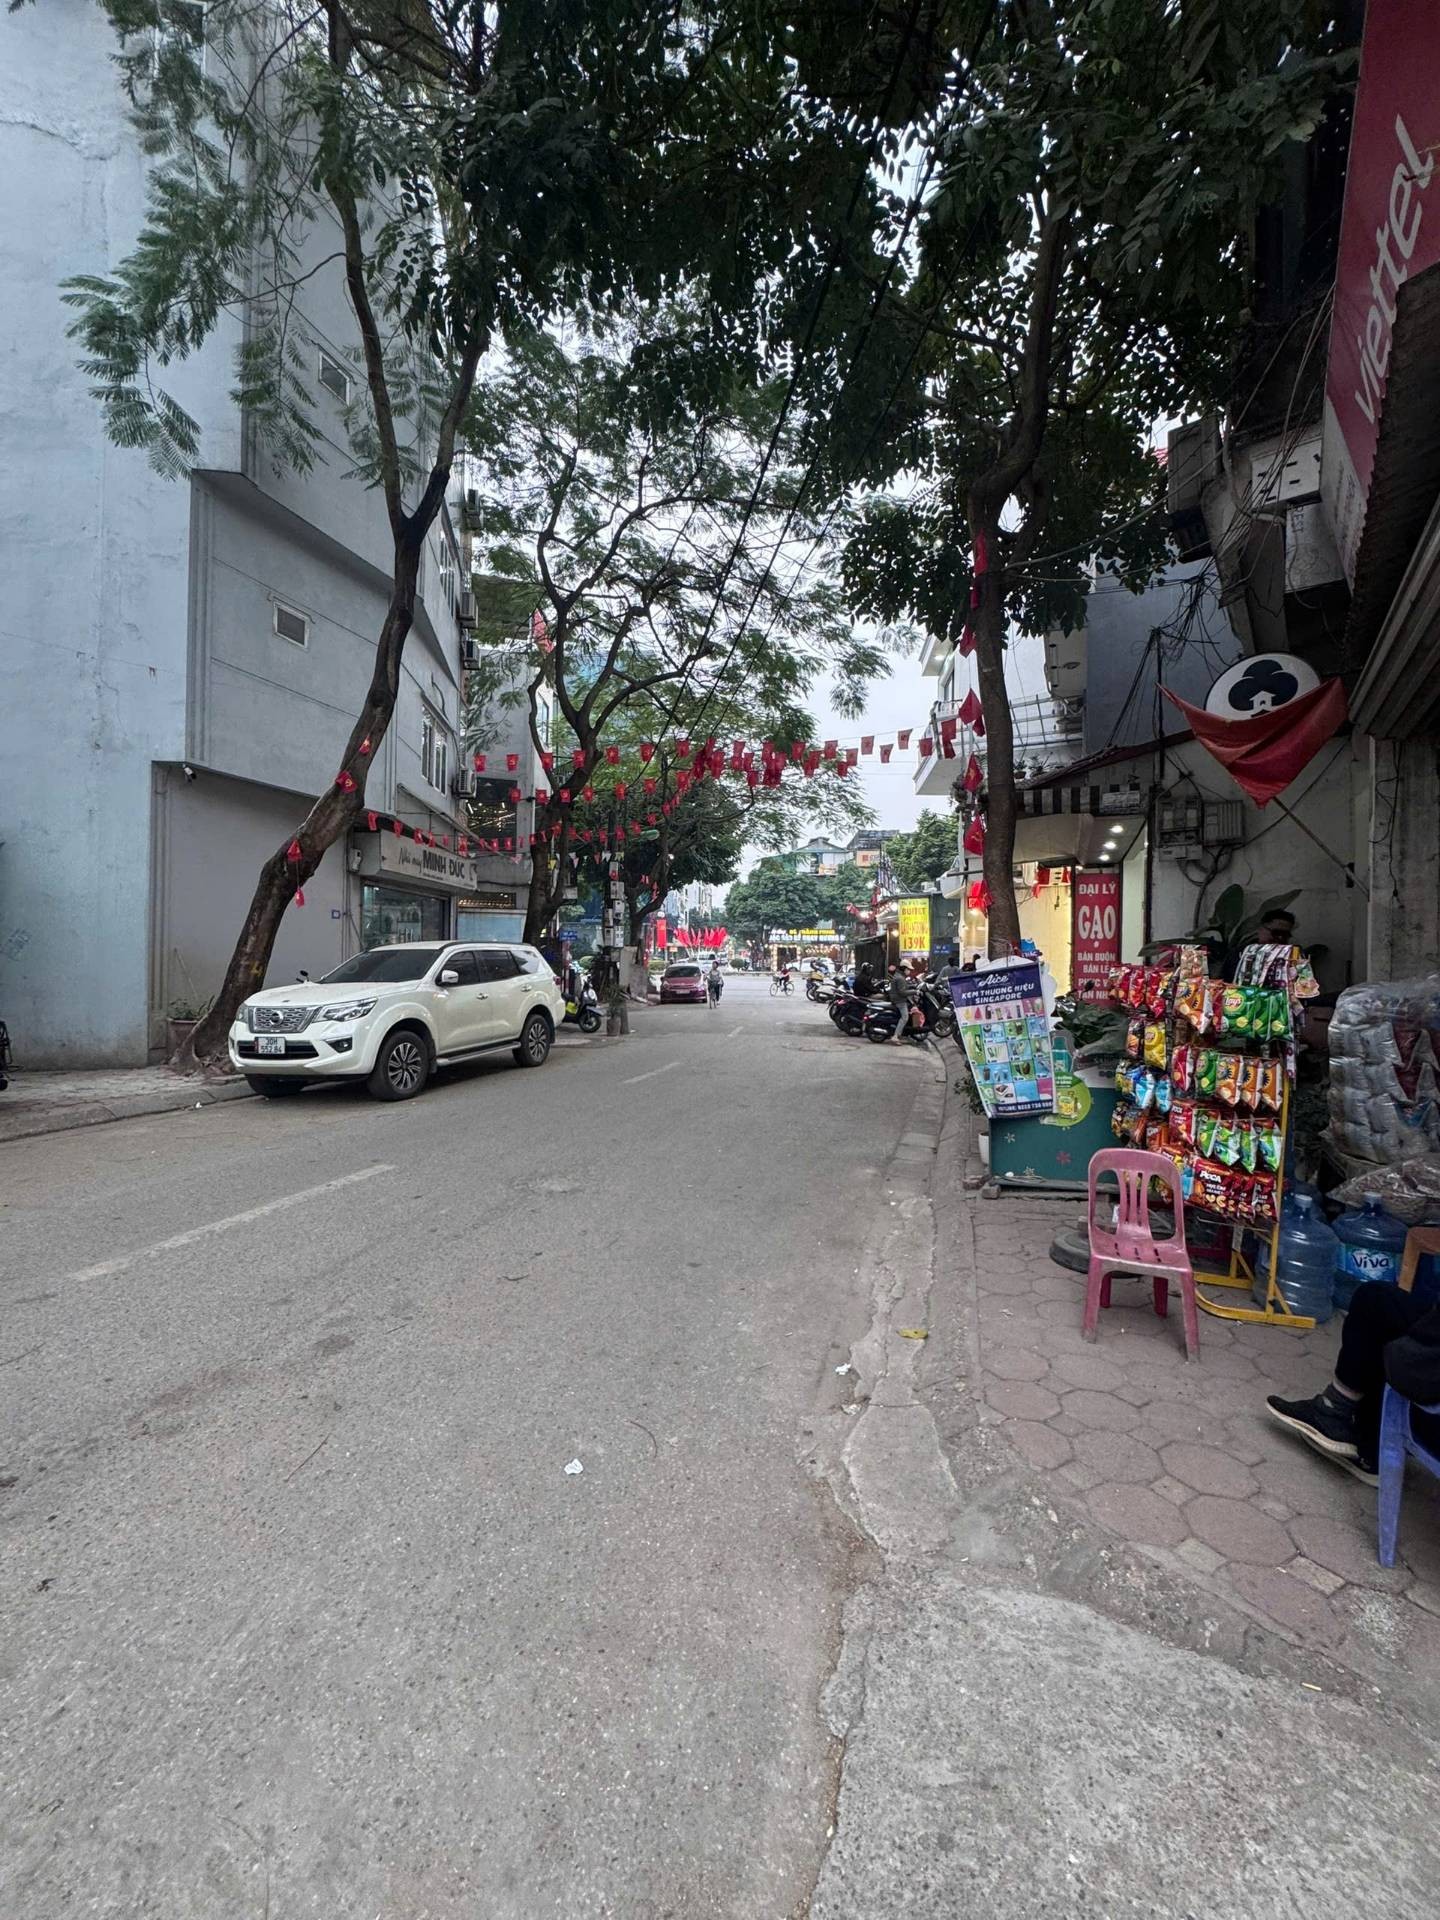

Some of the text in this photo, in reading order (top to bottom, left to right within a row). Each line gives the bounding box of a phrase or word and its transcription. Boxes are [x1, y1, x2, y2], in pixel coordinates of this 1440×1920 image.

[1355, 113, 1434, 424] viettel
[423, 849, 446, 874] MINH
[1079, 881, 1116, 896] ĐẠI LÝ
[1078, 905, 1116, 948] GẠO
[903, 936, 926, 949] 139K
[978, 973, 1009, 986] Aice
[961, 990, 979, 1000] KEM
[975, 992, 1022, 1004] SINGAPORE
